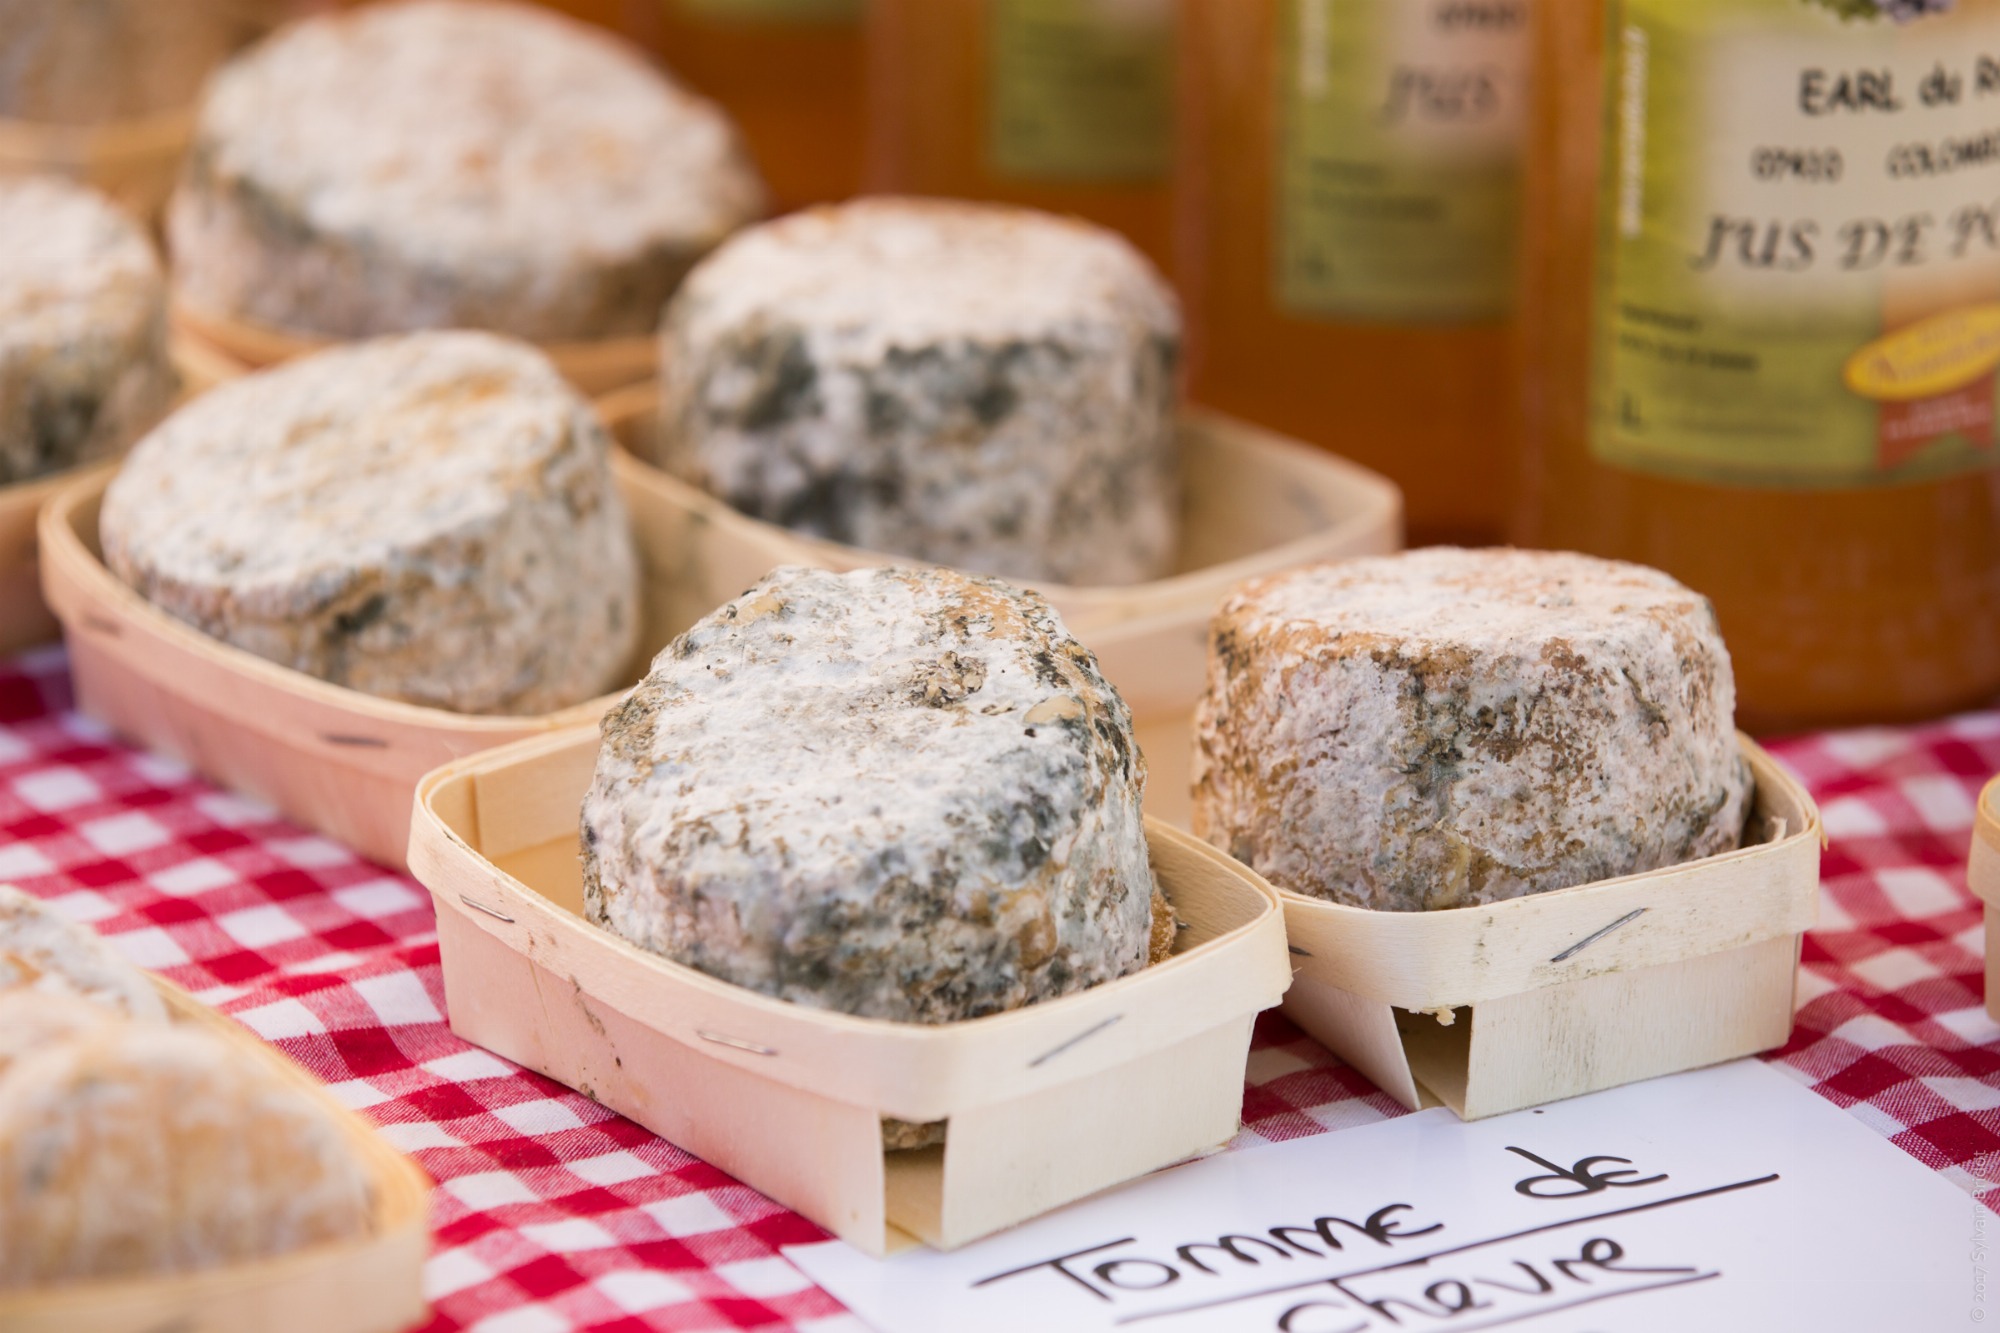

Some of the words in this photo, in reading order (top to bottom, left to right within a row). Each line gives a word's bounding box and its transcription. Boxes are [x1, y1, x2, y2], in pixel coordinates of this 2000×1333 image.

[1800, 66, 1902, 116] EARL
[1692, 212, 1818, 271] JUS
[1838, 209, 1932, 270] DE
